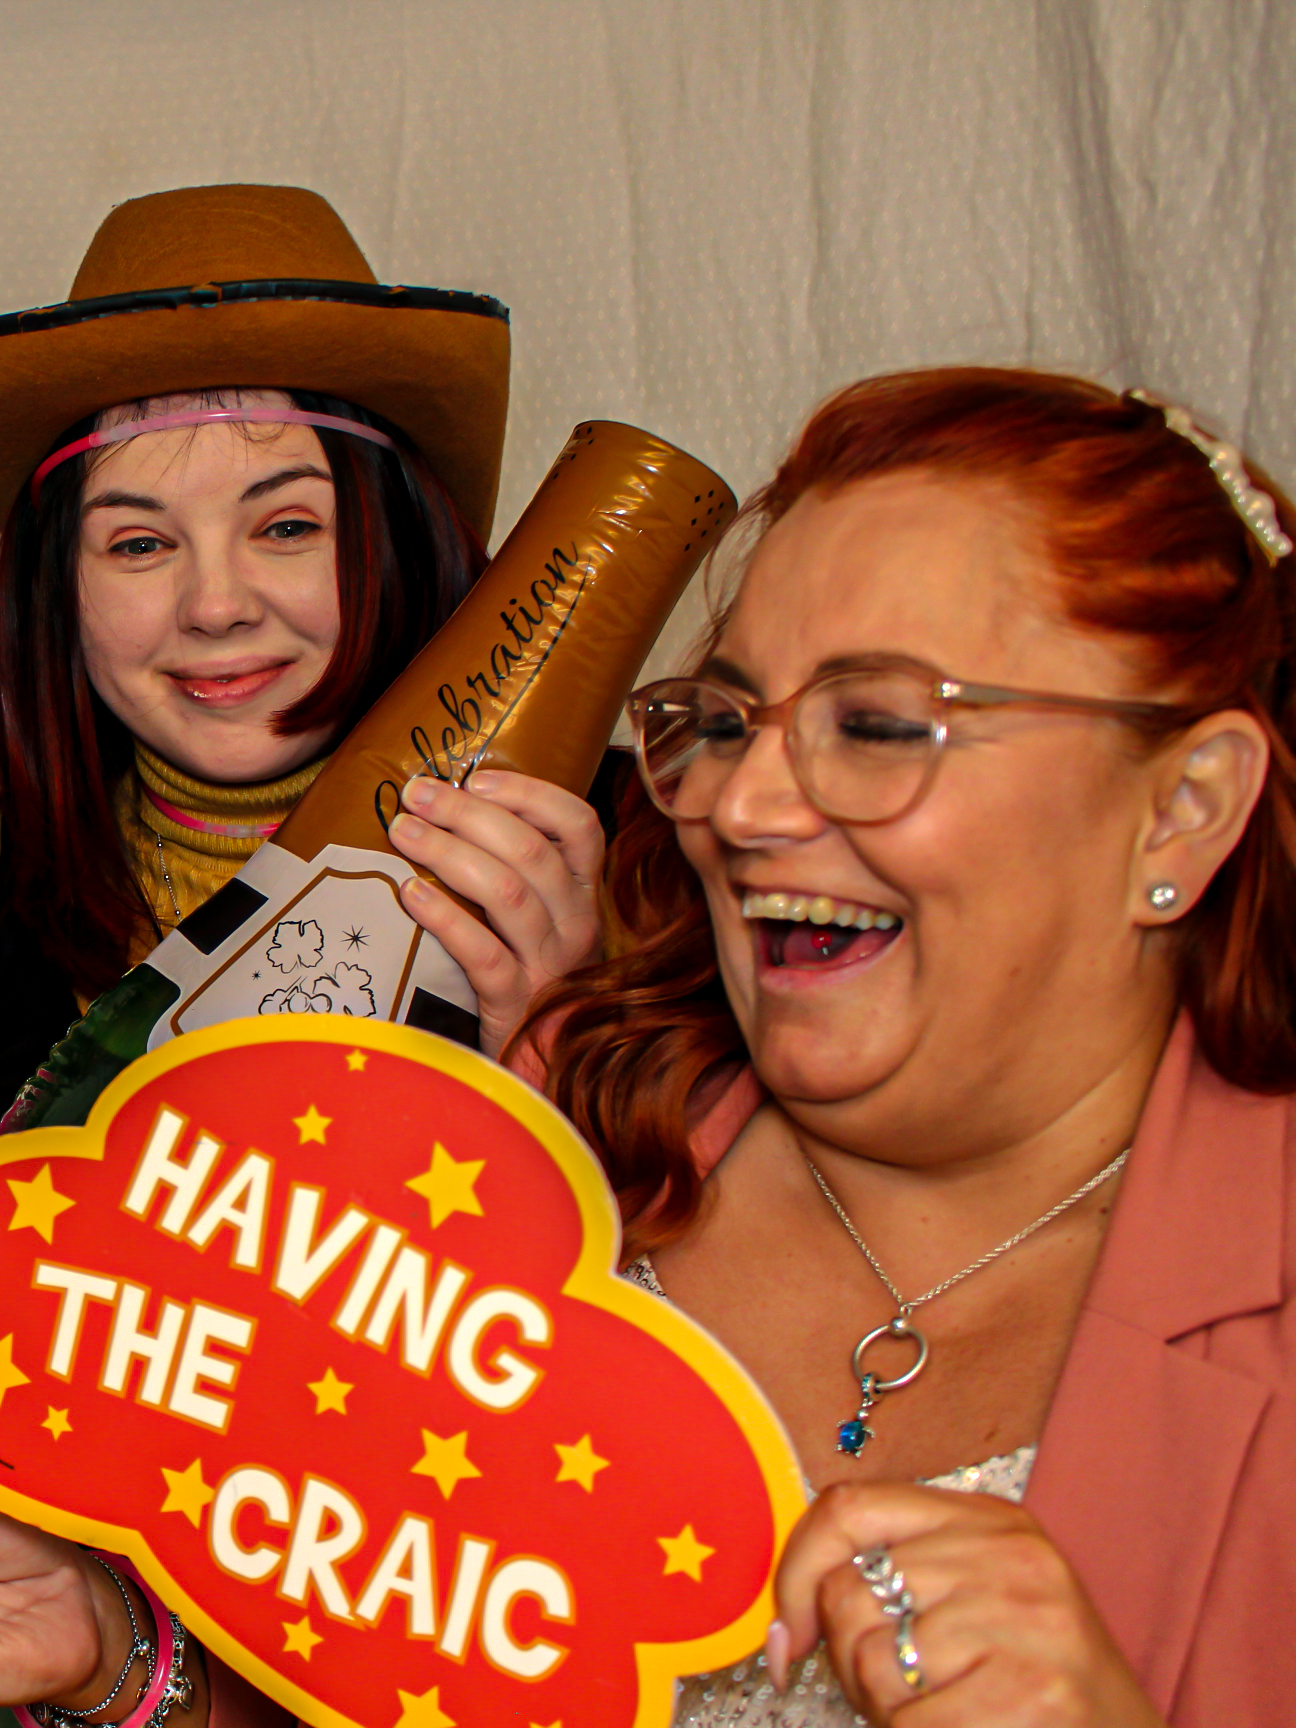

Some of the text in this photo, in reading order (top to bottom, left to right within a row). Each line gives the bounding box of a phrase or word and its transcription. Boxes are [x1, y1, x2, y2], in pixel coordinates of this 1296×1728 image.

[374, 541, 581, 836] lebration
[33, 1260, 257, 1434] THE
[123, 1104, 552, 1412] HAVING
[209, 1464, 575, 1682] CRAIC
